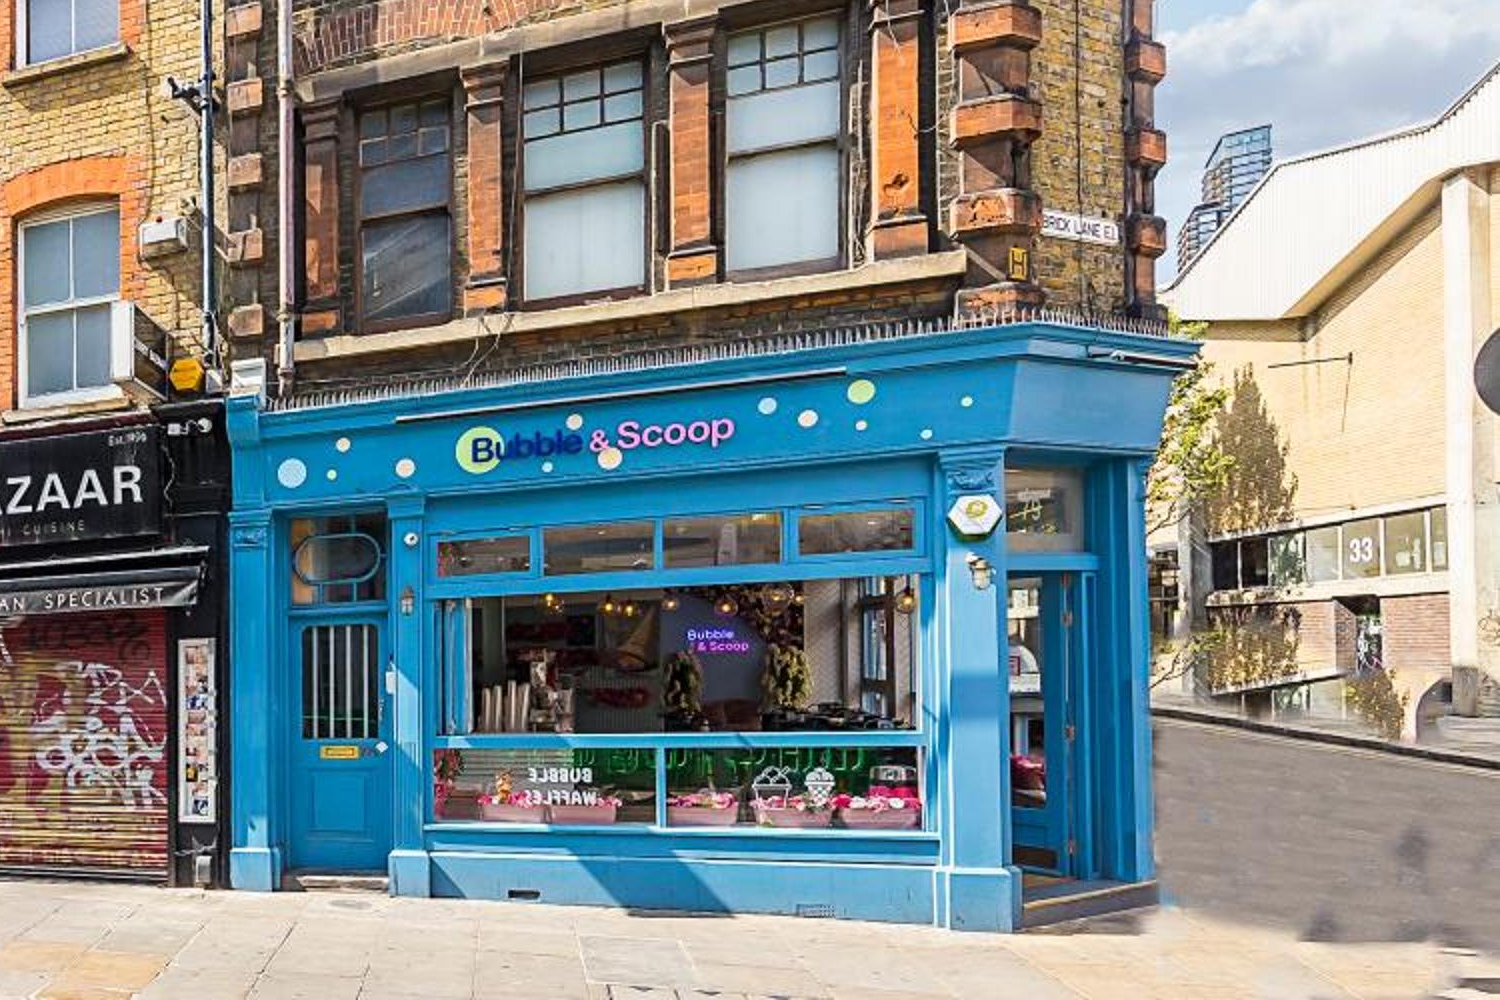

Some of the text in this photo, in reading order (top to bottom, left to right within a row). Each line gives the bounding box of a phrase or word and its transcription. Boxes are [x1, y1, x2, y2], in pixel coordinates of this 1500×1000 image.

[1043, 214, 1071, 233] BRICK
[1074, 220, 1100, 239] LANE
[471, 417, 735, 463] Bubble & Scoop
[1349, 537, 1373, 563] 33
[44, 587, 165, 609] SPECIALIST
[687, 629, 734, 640] Bubble
[709, 641, 749, 653] Scoop
